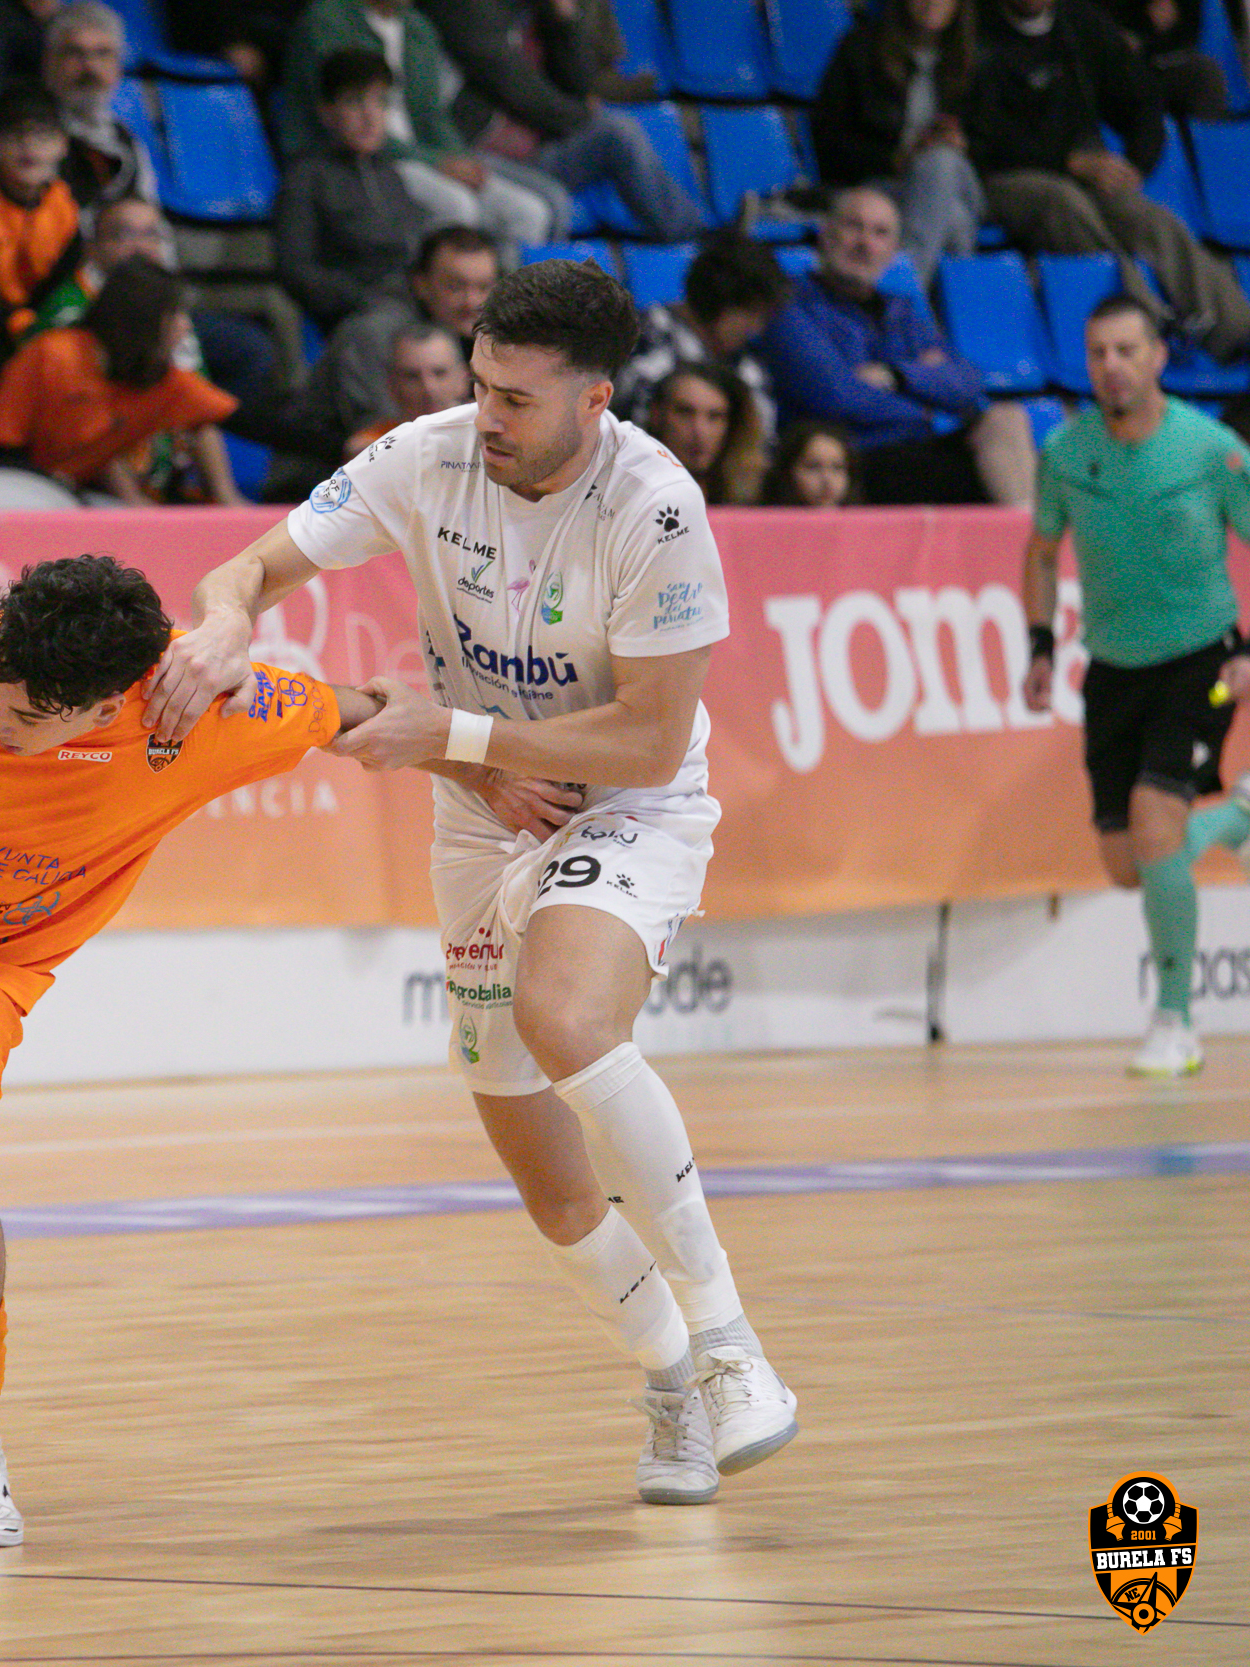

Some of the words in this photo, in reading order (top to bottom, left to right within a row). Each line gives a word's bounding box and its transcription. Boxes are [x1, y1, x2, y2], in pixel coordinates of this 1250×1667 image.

[437, 526, 498, 560] KELME
[657, 525, 690, 545] KELME
[457, 575, 495, 598] deportes
[60, 750, 112, 762] REYCO
[536, 854, 602, 900] 29
